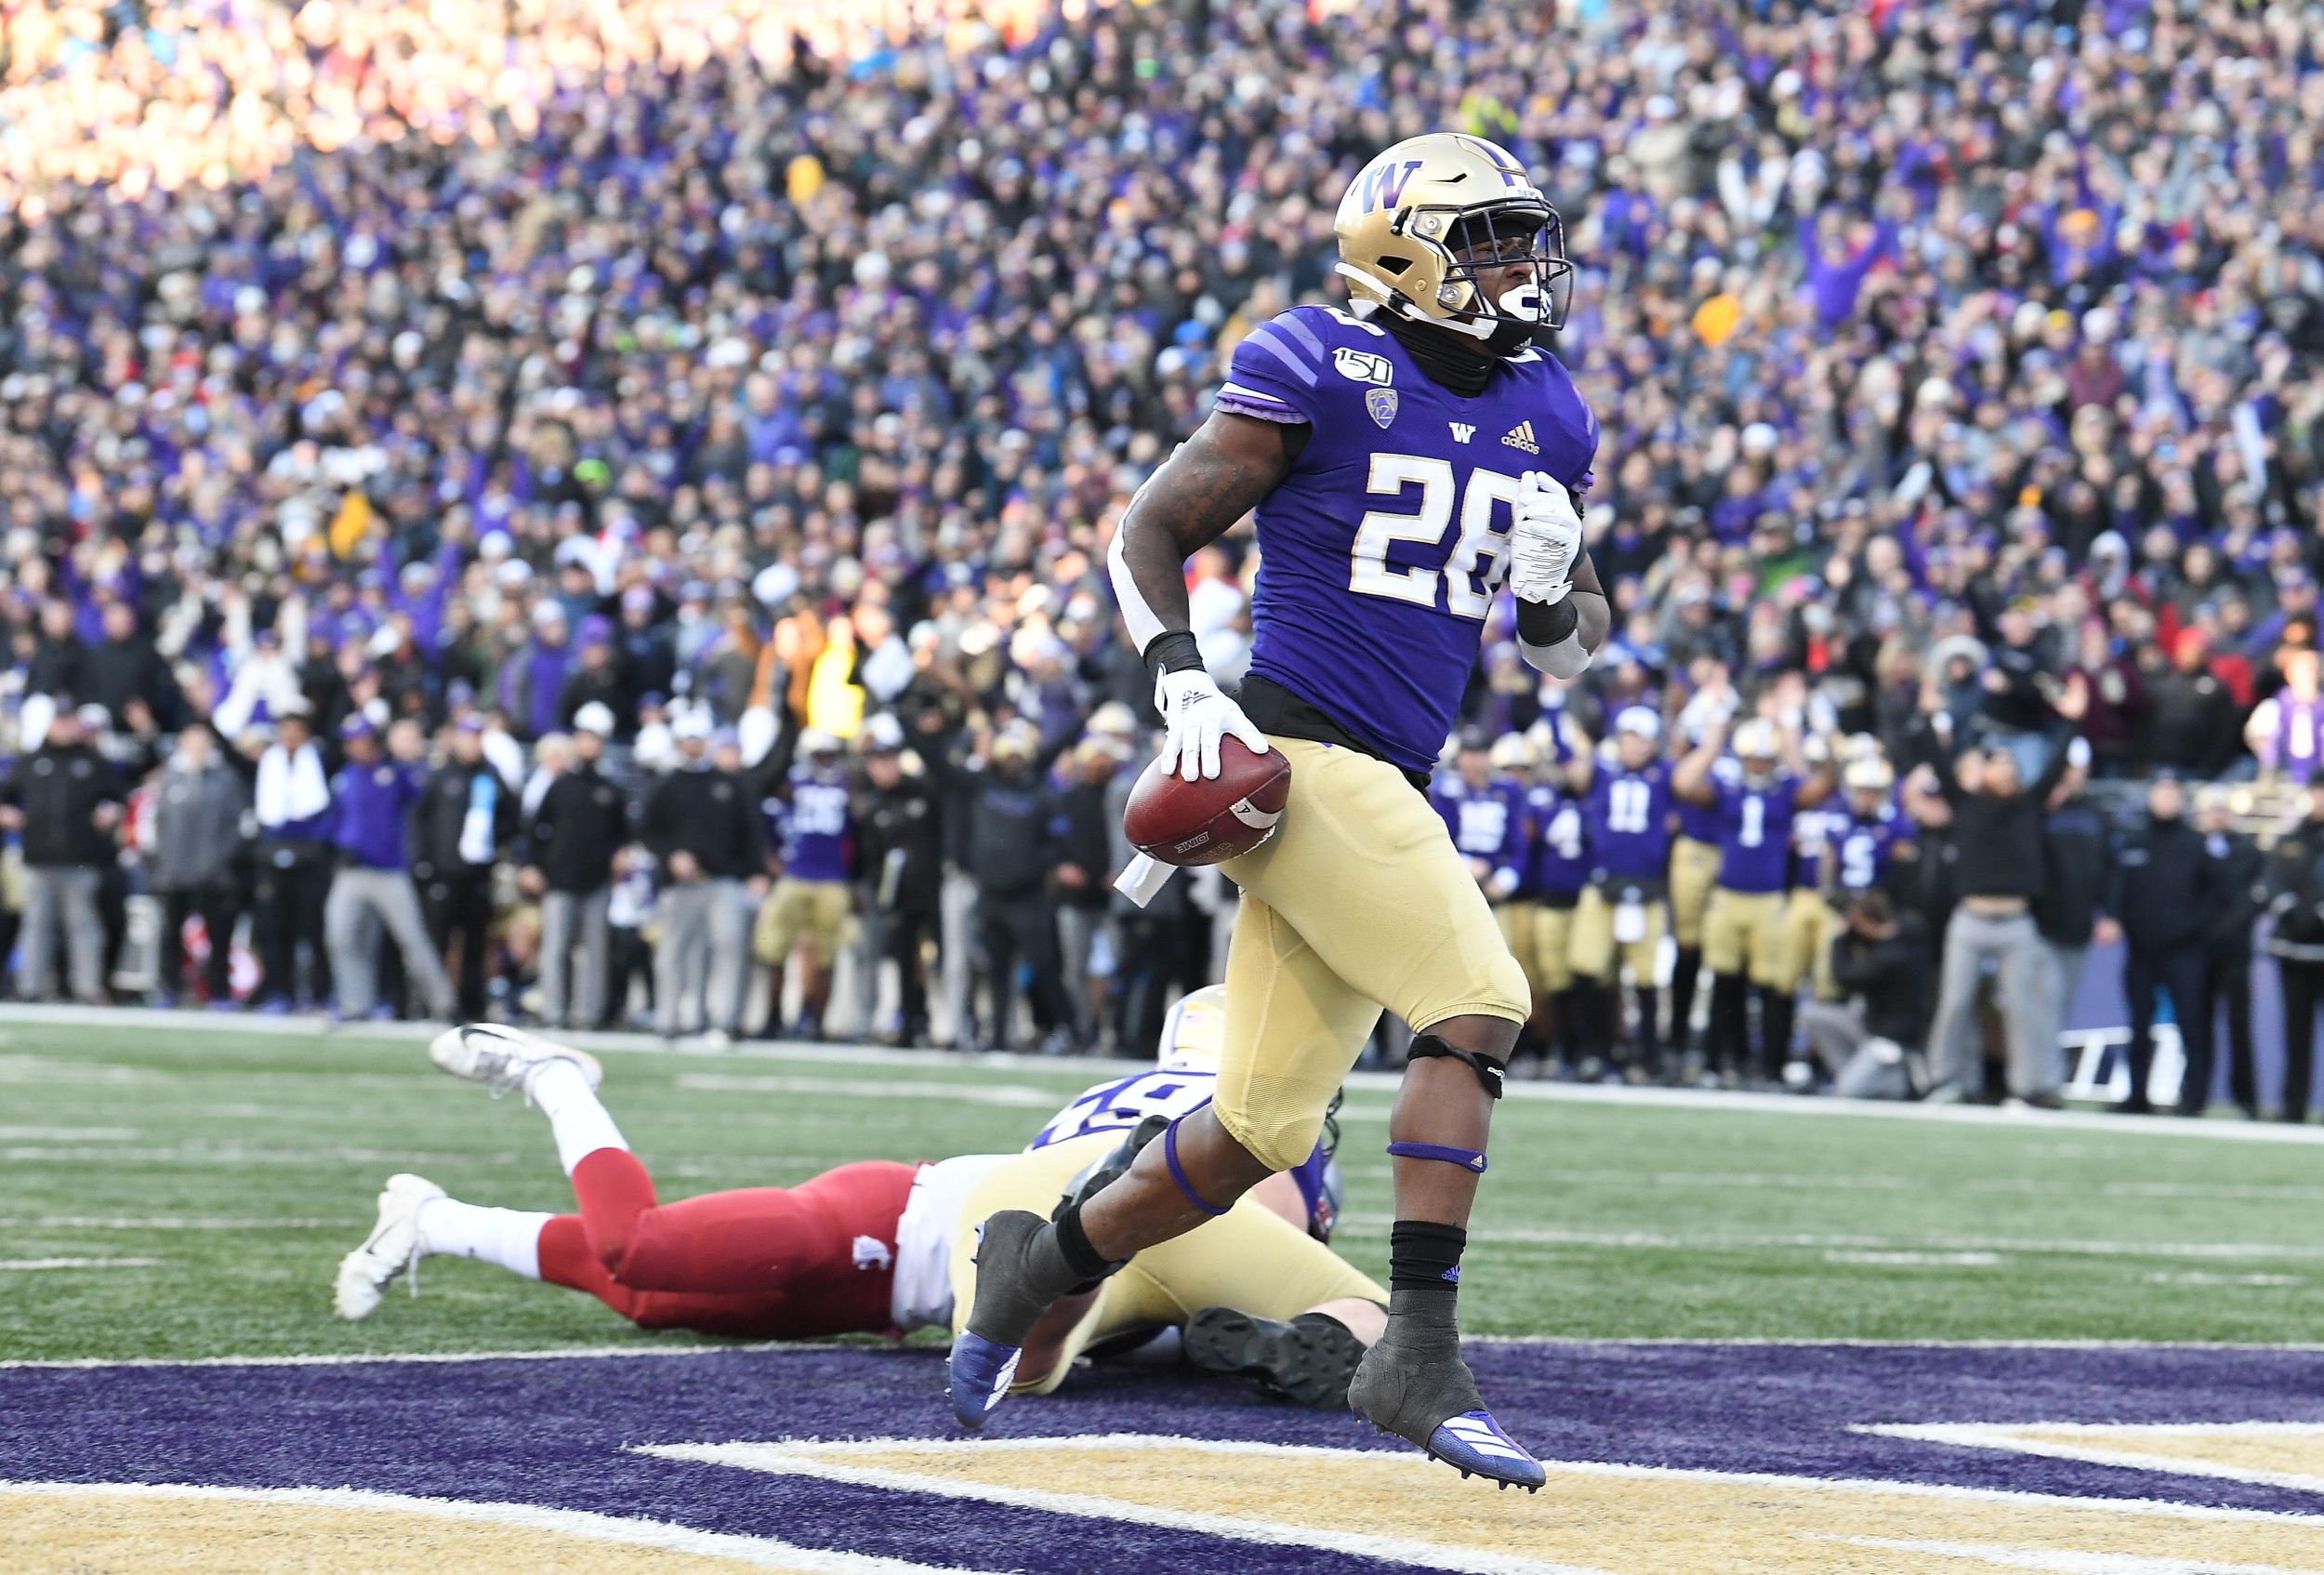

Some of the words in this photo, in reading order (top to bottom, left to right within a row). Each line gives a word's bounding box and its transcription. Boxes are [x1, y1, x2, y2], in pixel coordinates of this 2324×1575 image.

[1362, 160, 1423, 215] W
[1338, 349, 1391, 384] 150
[1448, 421, 1476, 444] W
[1500, 435, 1540, 455] adidas
[1608, 778, 1651, 834] 11
[1738, 794, 1765, 849] 1
[1174, 831, 1210, 854] DIME
